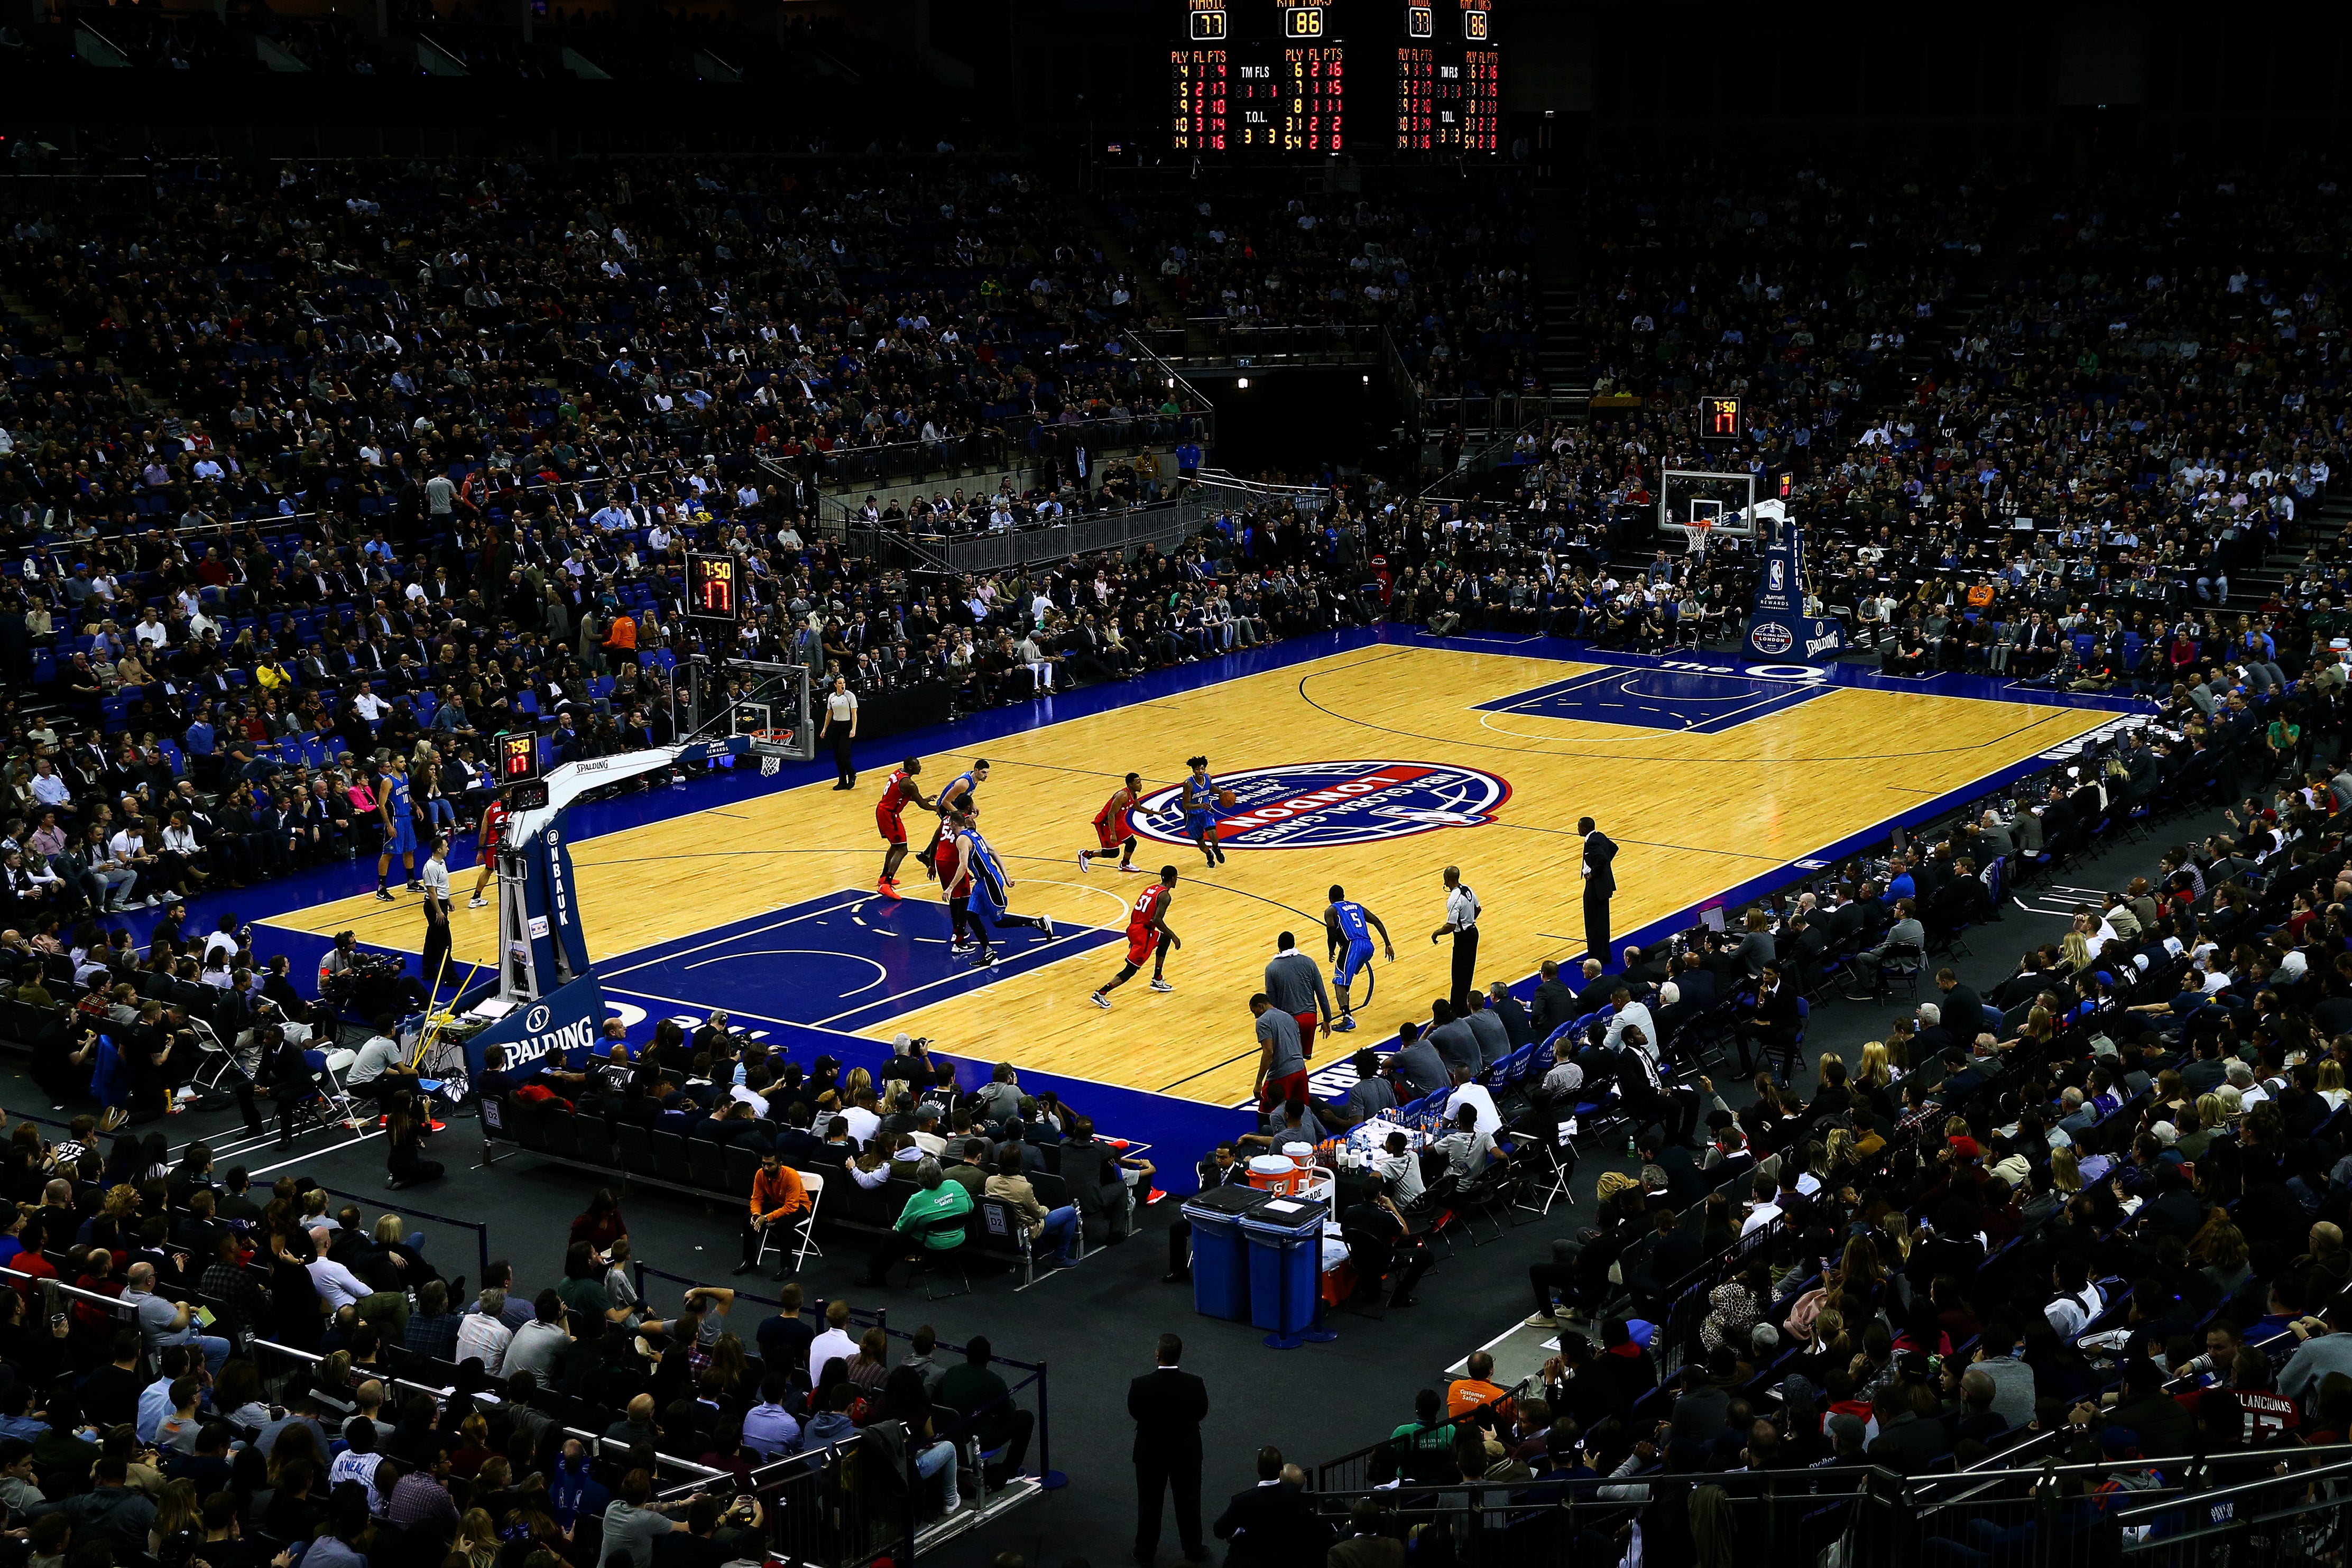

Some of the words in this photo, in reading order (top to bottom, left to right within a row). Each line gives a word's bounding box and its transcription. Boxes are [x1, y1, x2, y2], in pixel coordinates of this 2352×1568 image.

[1202, 15, 1222, 34] 77
[1297, 12, 1320, 33] 86
[1416, 12, 1429, 32] 77
[1472, 15, 1484, 36] 86
[1172, 51, 1188, 63] PLY
[1194, 51, 1205, 63] FL
[1207, 50, 1226, 63] PTS
[1286, 49, 1303, 61] PLY
[1309, 49, 1320, 61] FL
[1324, 48, 1342, 60] PTS
[1398, 48, 1409, 61] PLY
[1412, 49, 1419, 61] FL
[1421, 49, 1432, 61] PTS
[1466, 51, 1477, 63] PLY
[1479, 52, 1486, 63] FL
[1487, 52, 1498, 63] PTS
[1180, 65, 1188, 77] 4
[1217, 64, 1226, 77] 4
[1241, 66, 1253, 78] TM
[1255, 66, 1269, 78] FLS
[1295, 62, 1303, 77] 6
[1311, 62, 1318, 77] 2
[1329, 61, 1343, 77] 16
[1441, 66, 1449, 78] TM
[1449, 67, 1458, 78] FLS
[1180, 81, 1187, 96] 5
[1195, 81, 1203, 96] 2
[1213, 81, 1225, 95] 17
[1296, 80, 1302, 94] 7
[1329, 80, 1342, 95] 15
[1180, 99, 1187, 113] 9
[1195, 99, 1203, 115] 2
[1213, 99, 1225, 115] 10
[1294, 98, 1302, 113] 8
[1329, 99, 1341, 112] 11
[1176, 117, 1187, 132] 10
[1195, 117, 1202, 132] 3
[1212, 118, 1225, 131] 14
[1246, 111, 1268, 123] T.O.L.
[1286, 117, 1302, 132] 31
[1309, 116, 1317, 132] 2
[1332, 116, 1340, 132] 2
[1442, 111, 1455, 123] T.O.L.
[1175, 136, 1187, 148] 14
[1212, 135, 1225, 150] 16
[1244, 128, 1251, 144] 3
[1268, 128, 1275, 144] 3
[1285, 135, 1302, 150] 54
[1309, 135, 1317, 150] 2
[1332, 135, 1341, 150] 8
[1441, 128, 1446, 143] 3
[1455, 128, 1460, 143] 3
[1714, 401, 1736, 413] 7:50
[1717, 413, 1733, 432] 17
[702, 560, 731, 579] 7:50
[707, 581, 728, 610] 17
[1805, 630, 1839, 659] SPALDING
[1659, 661, 1734, 673] The
[508, 739, 530, 754] 7:50
[512, 755, 527, 774] 17
[576, 760, 608, 774] SPALDING
[883, 780, 891, 796] 8
[1402, 773, 1462, 789] NBA
[402, 794, 408, 804] 10
[1220, 776, 1399, 828] LONDON
[1316, 787, 1414, 815] GLOBAL
[940, 825, 955, 843] 54
[1236, 815, 1328, 842] GAMES
[547, 829, 568, 926] @NBAUK
[1134, 894, 1152, 913] 31
[1350, 912, 1362, 928] 5
[487, 1111, 498, 1120] D2
[1274, 1183, 1283, 1193] G
[934, 1192, 954, 1204] Customer
[938, 1197, 954, 1206] Safety
[990, 1217, 1003, 1227] D2
[1460, 1389, 1486, 1399] Customer
[1462, 1395, 1480, 1404] Safety
[2236, 1393, 2292, 1414] LANCIUNAS
[2242, 1412, 2284, 1444] 17
[338, 1460, 367, 1475] O'NEAL
